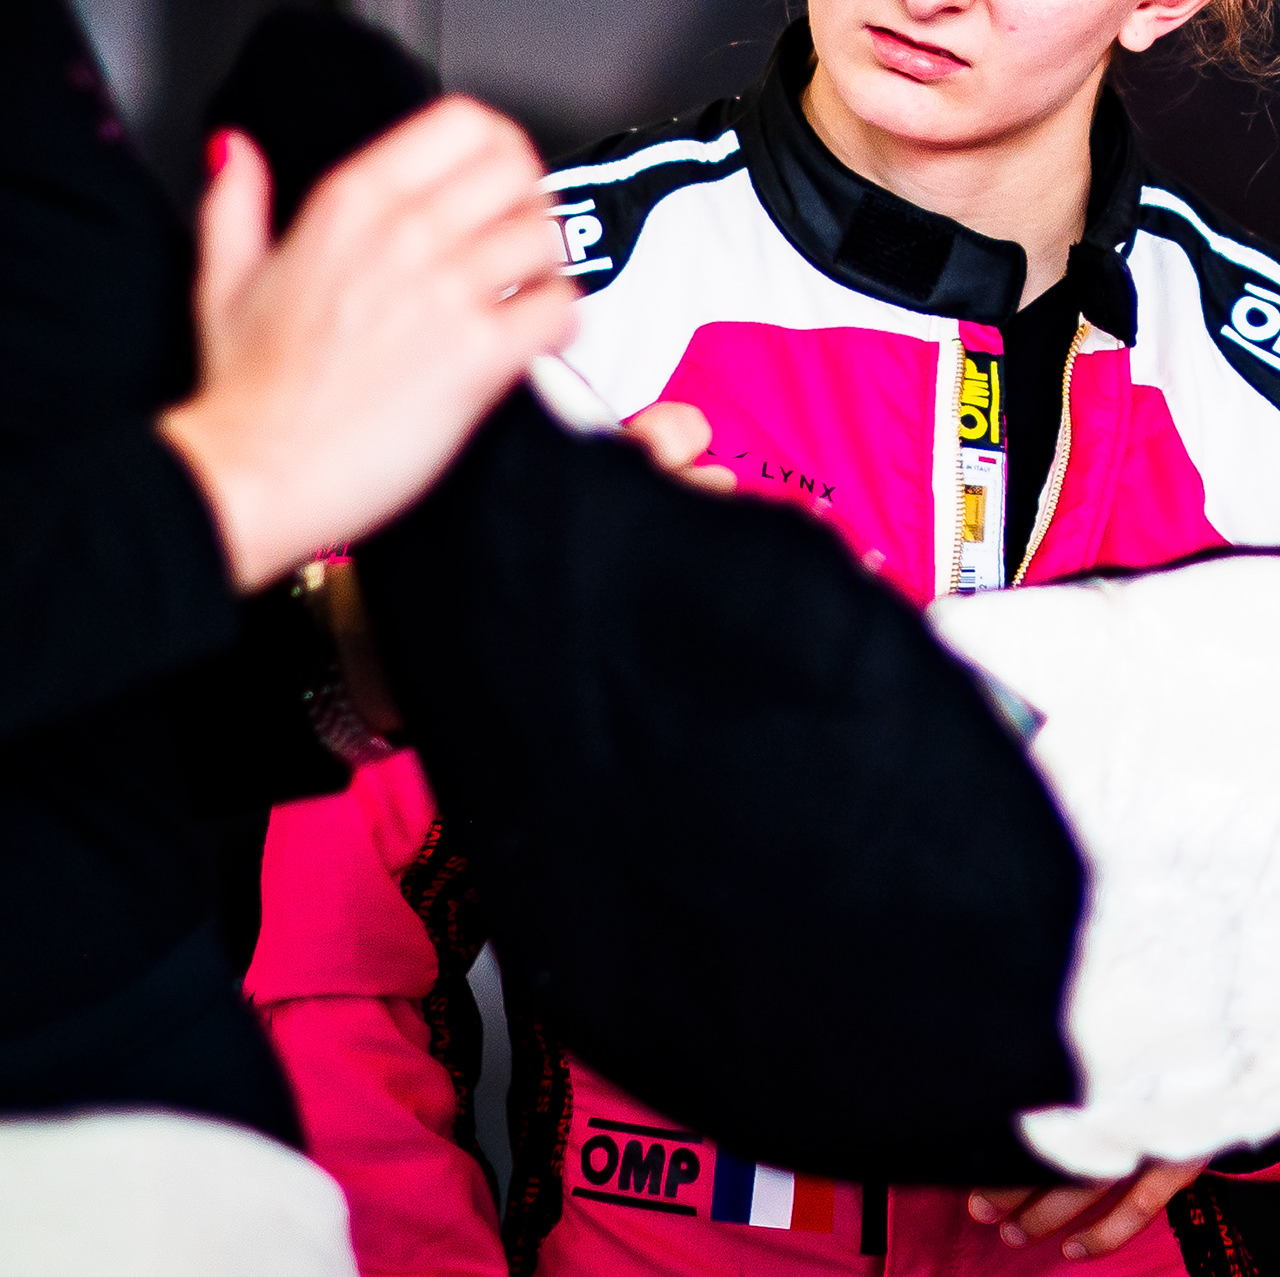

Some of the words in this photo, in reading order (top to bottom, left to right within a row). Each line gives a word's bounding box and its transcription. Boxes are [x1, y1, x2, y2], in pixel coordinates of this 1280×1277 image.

[958, 358, 989, 440] OMP
[761, 461, 836, 503] LYNX
[581, 1134, 701, 1198] OMP
